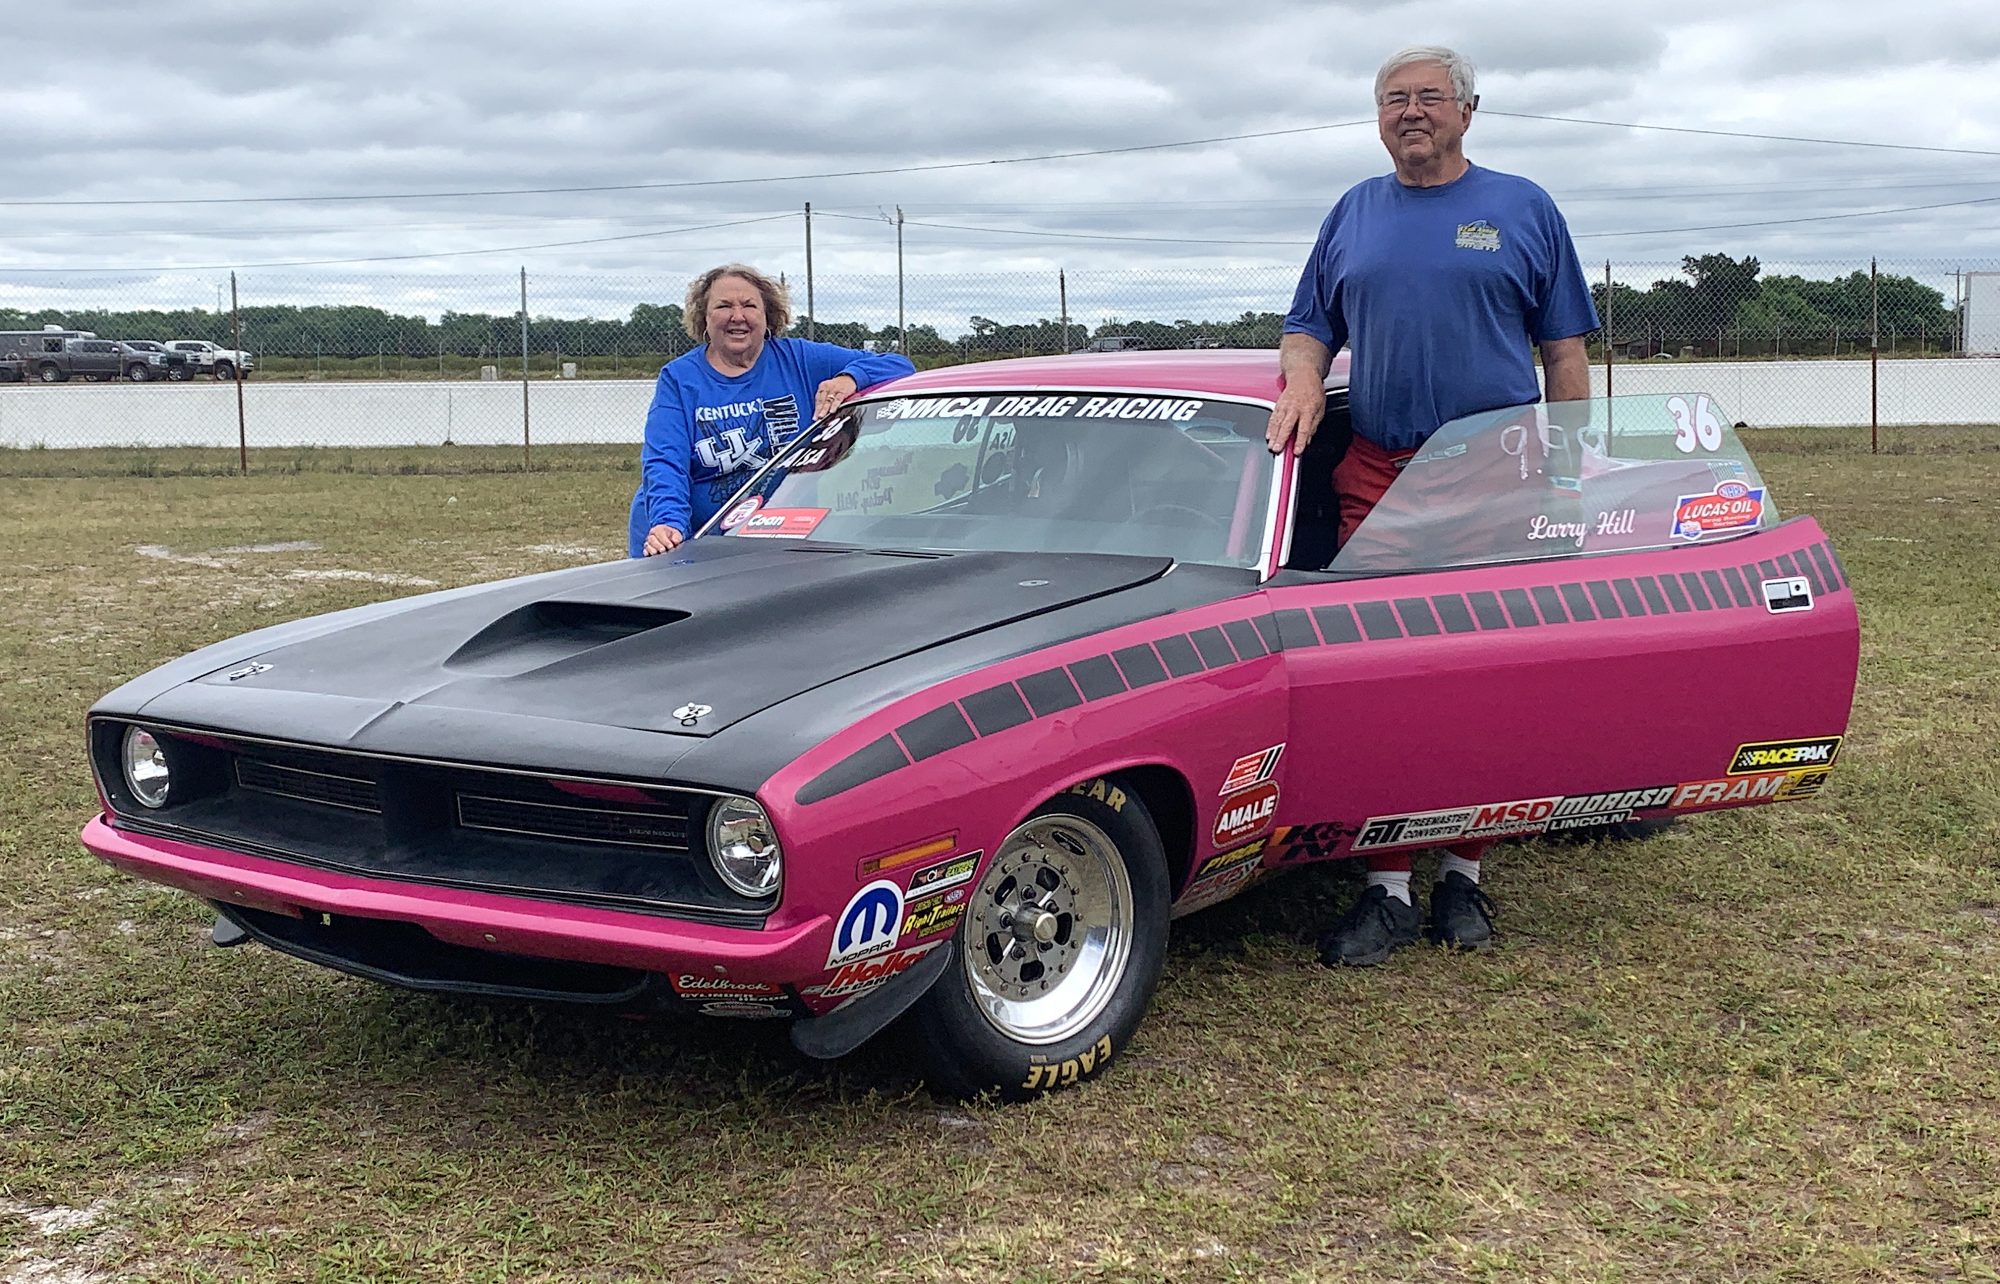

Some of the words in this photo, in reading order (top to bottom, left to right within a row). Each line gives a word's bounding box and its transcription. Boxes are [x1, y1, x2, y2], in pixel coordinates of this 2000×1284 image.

[890, 397, 990, 419] NMCA
[987, 397, 1075, 418] DRAG
[1074, 397, 1203, 421] RACING
[762, 394, 800, 458] WIL
[1666, 395, 1721, 453] 36
[695, 427, 768, 476] UK
[747, 514, 786, 527] Coan
[1683, 501, 1730, 520] LUCAS
[1730, 500, 1753, 513] OIL
[1527, 514, 1588, 547] Larry
[1597, 509, 1636, 536] Hill
[1751, 745, 1832, 766] RACEPAK
[1060, 779, 1127, 813] EAR
[1672, 776, 1787, 806] FRAM
[1216, 795, 1276, 834] AMALIE
[1473, 801, 1554, 828] MSD
[1550, 814, 1625, 830] LINCOLN
[830, 940, 892, 966] MOPAR
[678, 974, 771, 991] Edelbrock
[1022, 1034, 1112, 1089] EAGLE
